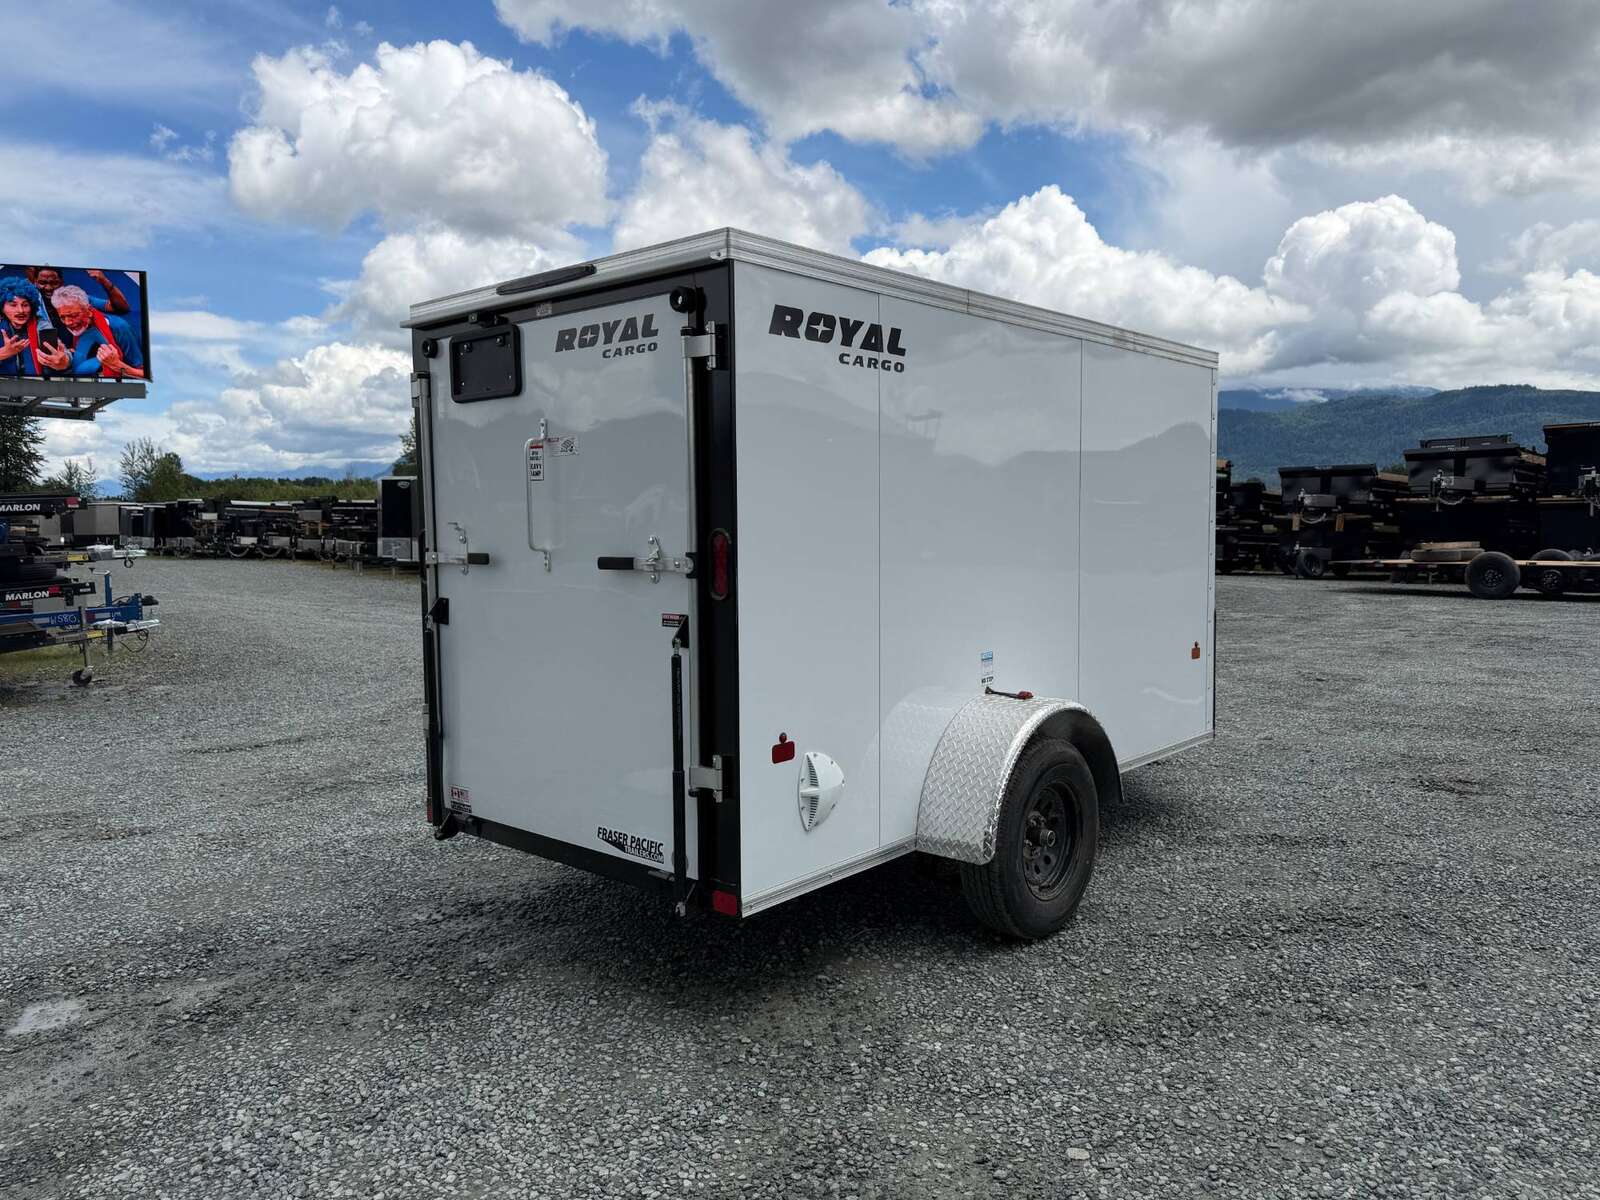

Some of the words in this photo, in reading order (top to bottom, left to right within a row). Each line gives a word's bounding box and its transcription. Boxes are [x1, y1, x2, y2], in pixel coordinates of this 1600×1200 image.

[555, 313, 659, 352] ROYAL
[768, 304, 907, 357] ROYAL
[602, 342, 658, 359] CARGO
[838, 352, 905, 373] CARGO
[0, 503, 41, 512] MARLON
[5, 590, 50, 601] MARLON
[597, 826, 629, 846] FRASER
[630, 835, 664, 857] PACIFIC
